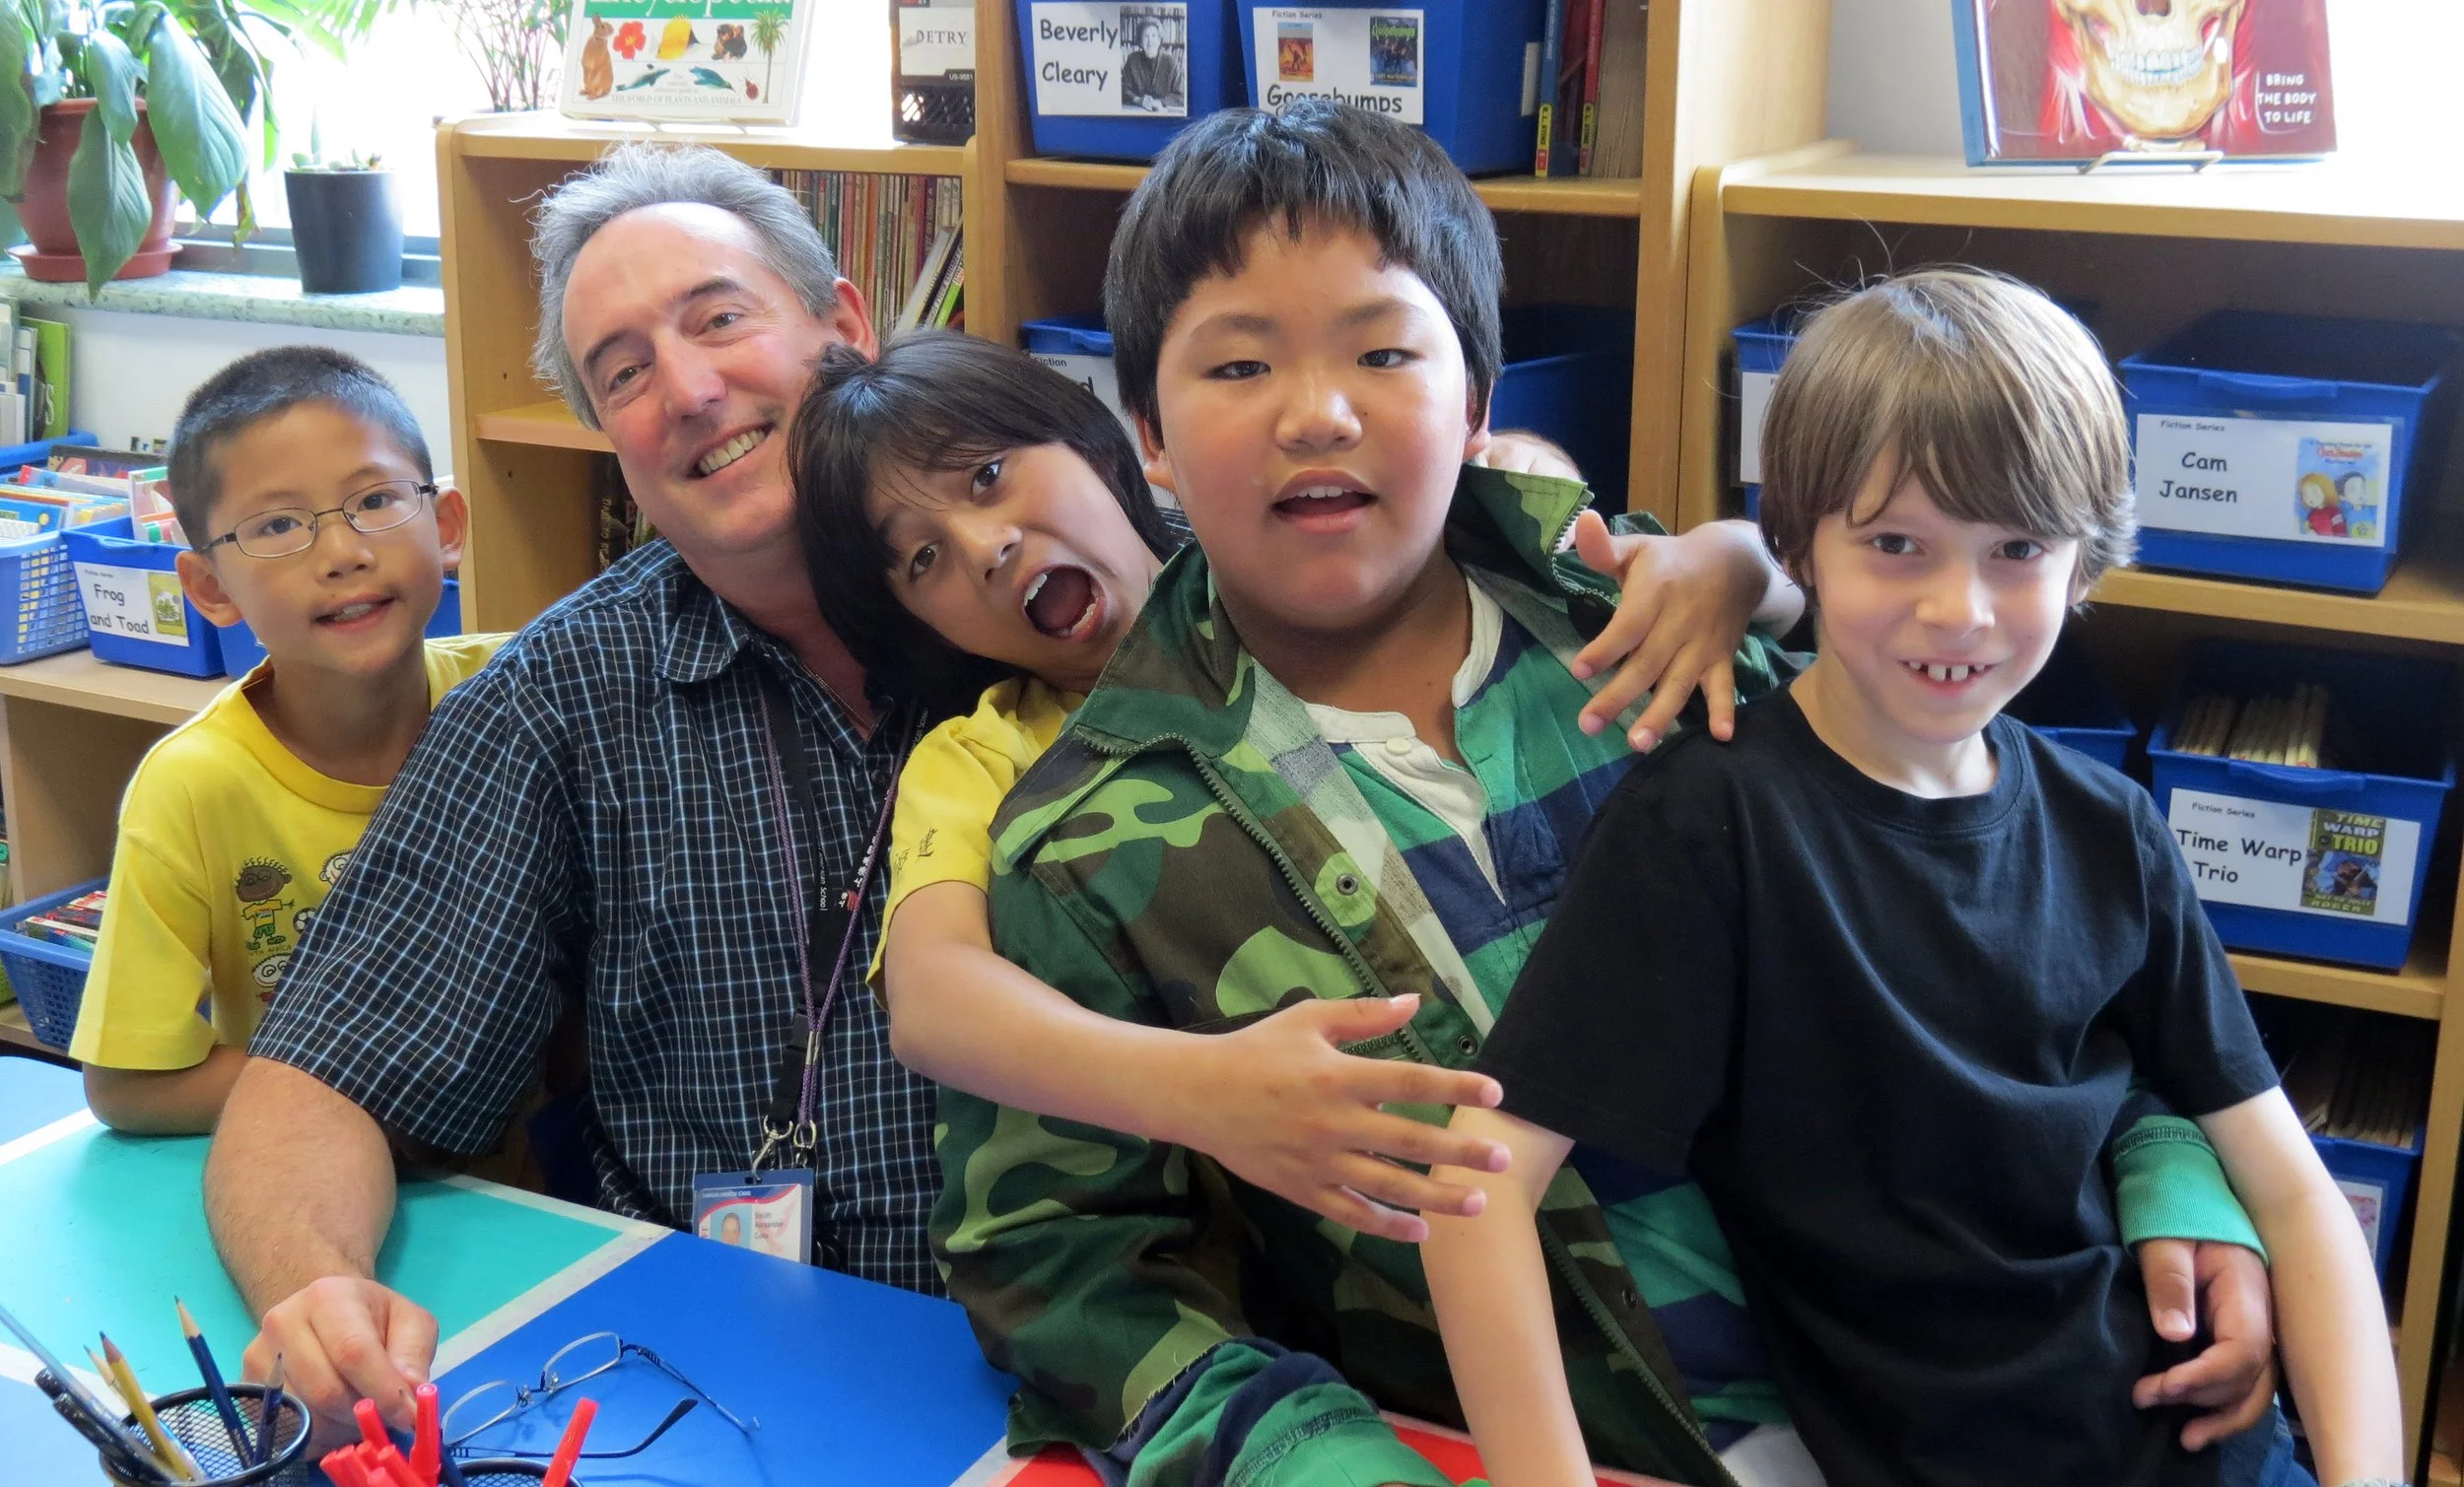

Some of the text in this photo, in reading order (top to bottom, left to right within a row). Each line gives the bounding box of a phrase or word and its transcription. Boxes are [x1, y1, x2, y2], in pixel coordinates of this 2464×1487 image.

[1271, 9, 1323, 20] Fiction Series
[1040, 18, 1119, 49] Beverly
[1042, 60, 1109, 92] Cleary
[2266, 73, 2304, 87] BRING
[2257, 92, 2317, 105] THE BODY
[2264, 109, 2311, 124] TO LIFE
[2160, 420, 2225, 432] Fiction Series
[2181, 451, 2227, 472] Cam
[2158, 480, 2237, 504] Jansen
[94, 583, 125, 607] Frog
[90, 613, 151, 635] and Toad
[2192, 802, 2255, 819] Fiction Series
[2337, 813, 2384, 828] TIME
[2323, 822, 2380, 837] WARP
[2176, 829, 2302, 866] Time Warp
[2333, 834, 2378, 854] TRIO
[2193, 861, 2238, 883] Trio
[819, 887, 828, 912] School
